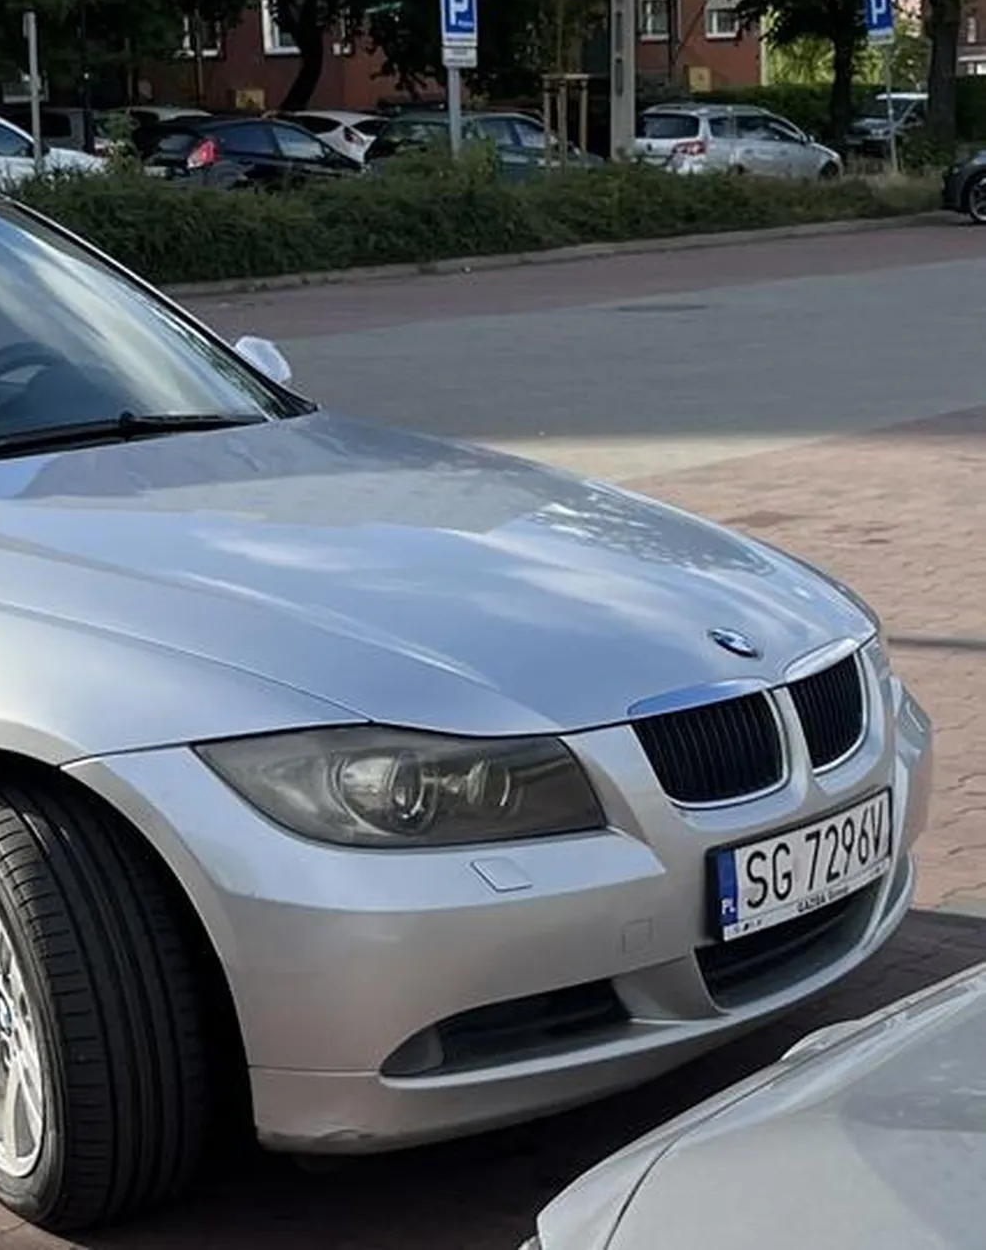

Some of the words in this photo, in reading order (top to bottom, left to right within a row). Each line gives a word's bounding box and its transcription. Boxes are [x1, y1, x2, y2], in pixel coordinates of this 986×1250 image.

[746, 842, 792, 908] SG
[805, 800, 883, 891] 7296V
[721, 898, 735, 915] PL
